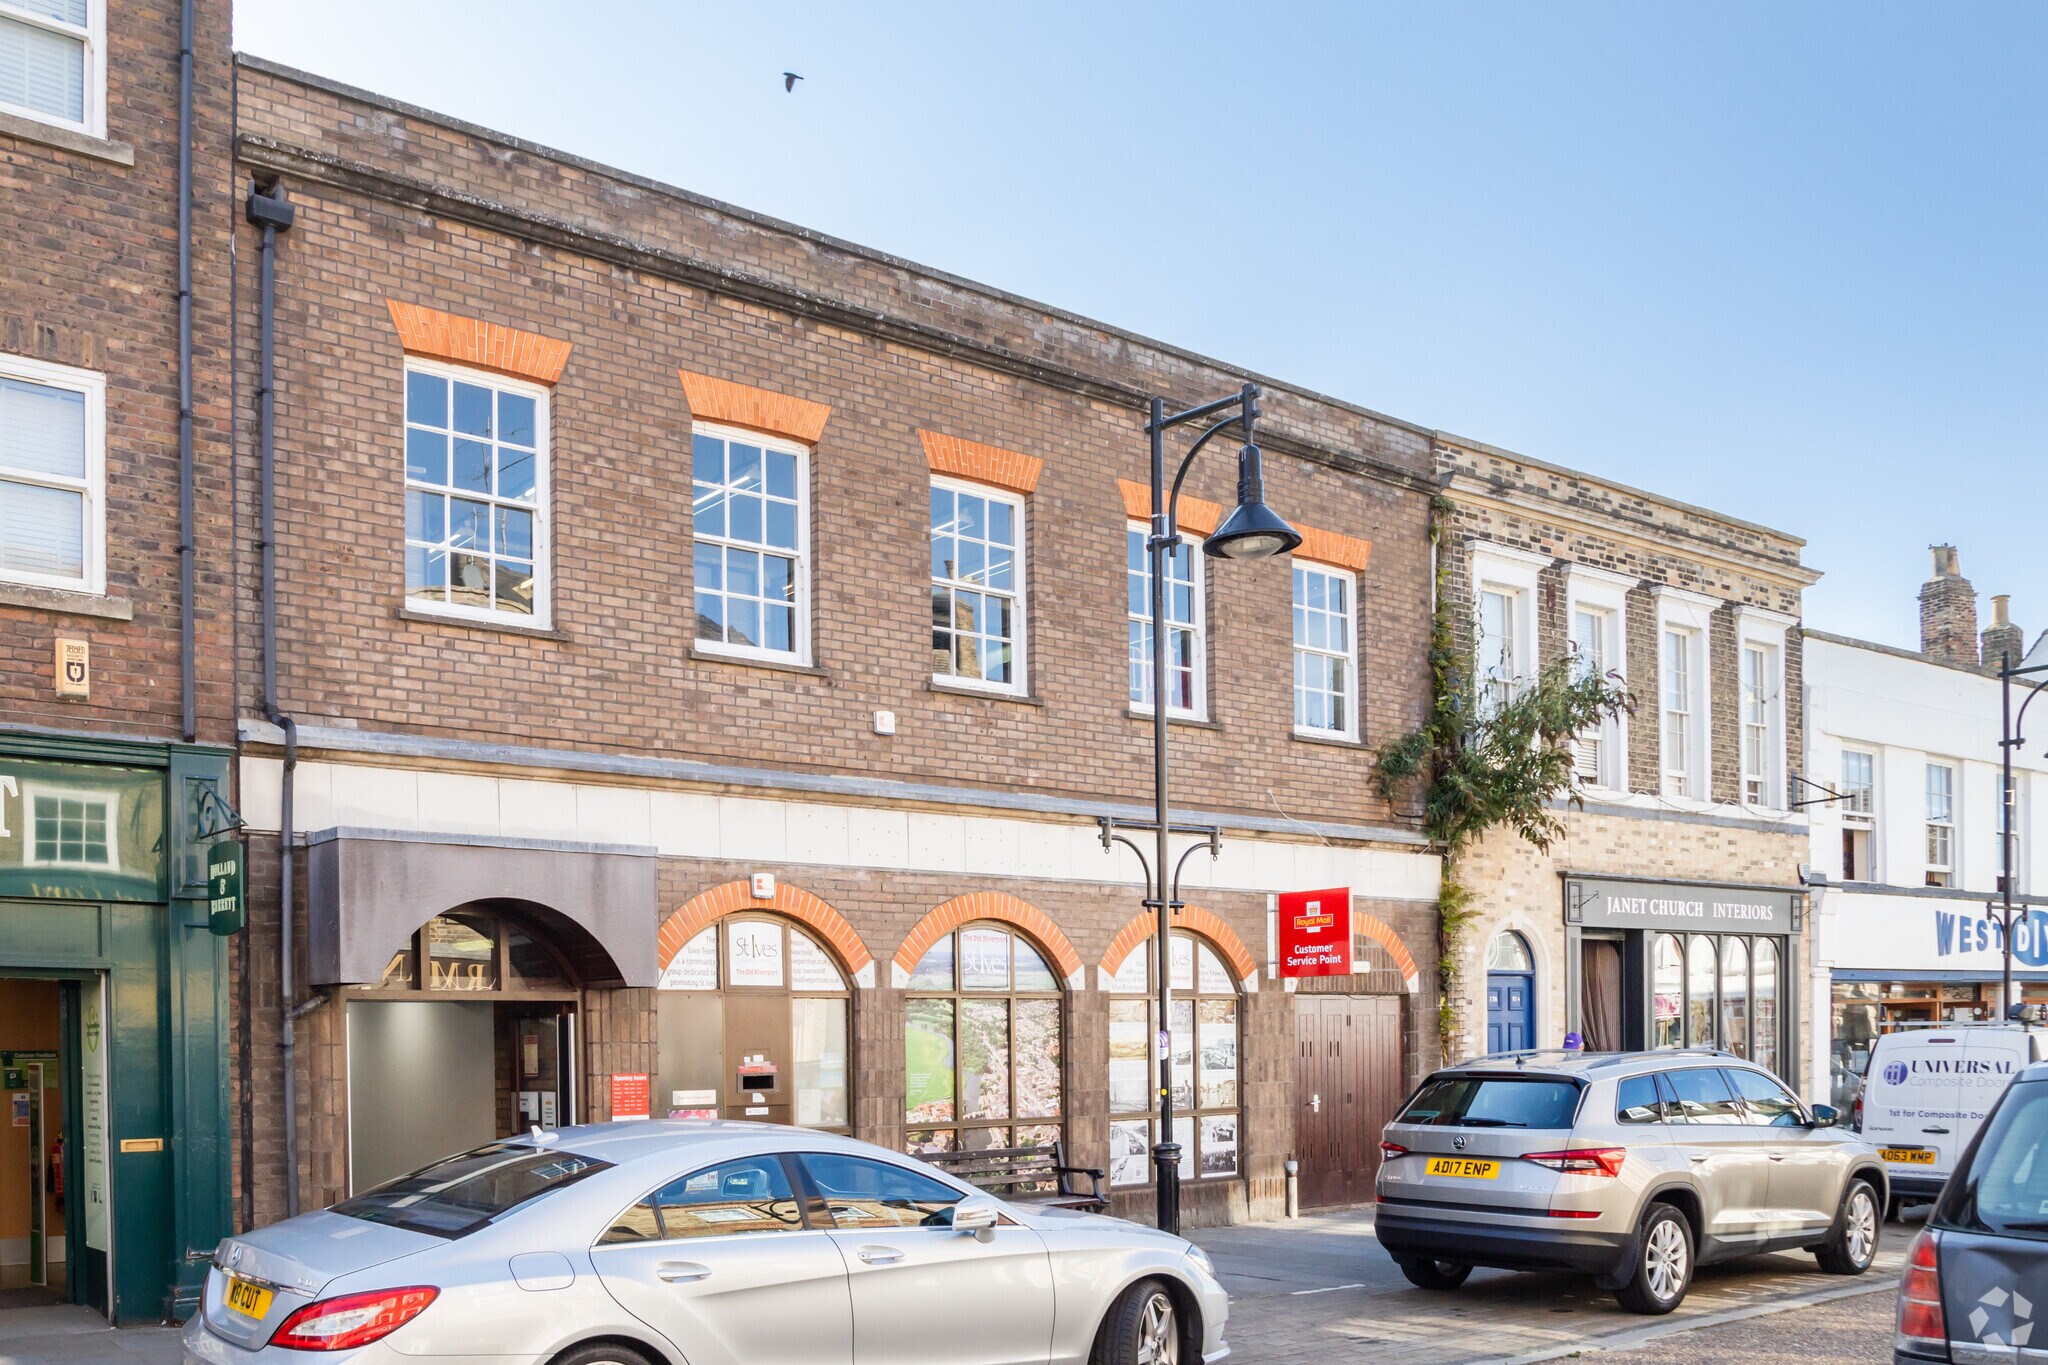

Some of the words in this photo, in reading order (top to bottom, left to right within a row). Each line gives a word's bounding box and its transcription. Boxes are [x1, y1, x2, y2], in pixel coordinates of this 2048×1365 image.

[210, 860, 236, 880] HOLLAND
[1607, 896, 1648, 916] JANET
[1650, 898, 1704, 917] CHURCH
[1713, 902, 1773, 921] INTERIORS
[1296, 917, 1315, 927] Royal
[1315, 915, 1331, 925] Mail
[1935, 910, 2007, 957] WEST
[736, 937, 750, 957] St
[751, 934, 778, 958] Ives
[1294, 944, 1334, 955] Customer
[980, 945, 1007, 974] Ives
[1287, 955, 1318, 967] Service
[1319, 954, 1342, 965] Point
[1911, 1060, 2016, 1075] UNIVERSAL
[1909, 1075, 1974, 1088] Composite
[1976, 1077, 2012, 1088] Door
[1889, 1109, 1901, 1117] 1st
[1903, 1110, 1915, 1118] for
[1918, 1111, 1968, 1120] Composite
[1463, 1161, 1492, 1176] ENP
[240, 1283, 260, 1312] CUT
